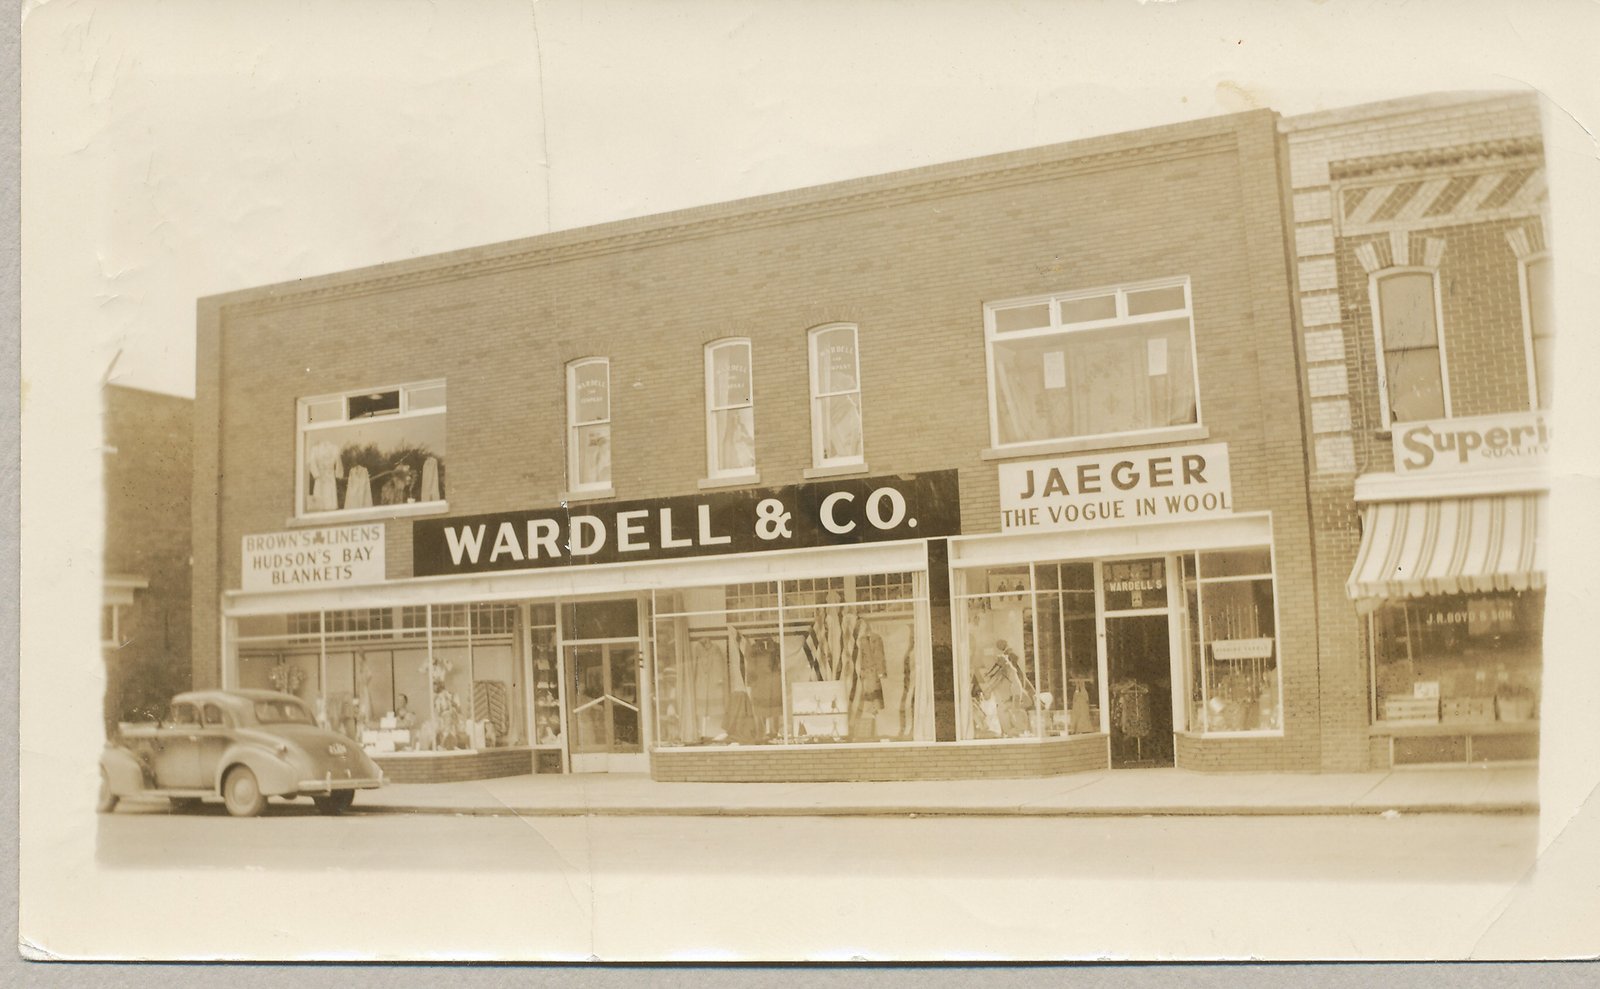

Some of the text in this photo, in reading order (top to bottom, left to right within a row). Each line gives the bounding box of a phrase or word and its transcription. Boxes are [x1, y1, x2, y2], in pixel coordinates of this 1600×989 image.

[1402, 417, 1552, 470] Superi
[1020, 454, 1208, 500] JAEGER
[1002, 492, 1231, 528] THE VOGUE IN WOOL
[247, 525, 381, 551] BROWN'S LINENS
[443, 486, 918, 566] WARDELL & CO.
[253, 546, 374, 569] HUDSON'S BAY
[272, 565, 353, 585] BLANKETS
[1109, 579, 1163, 592] WARDELL'S
